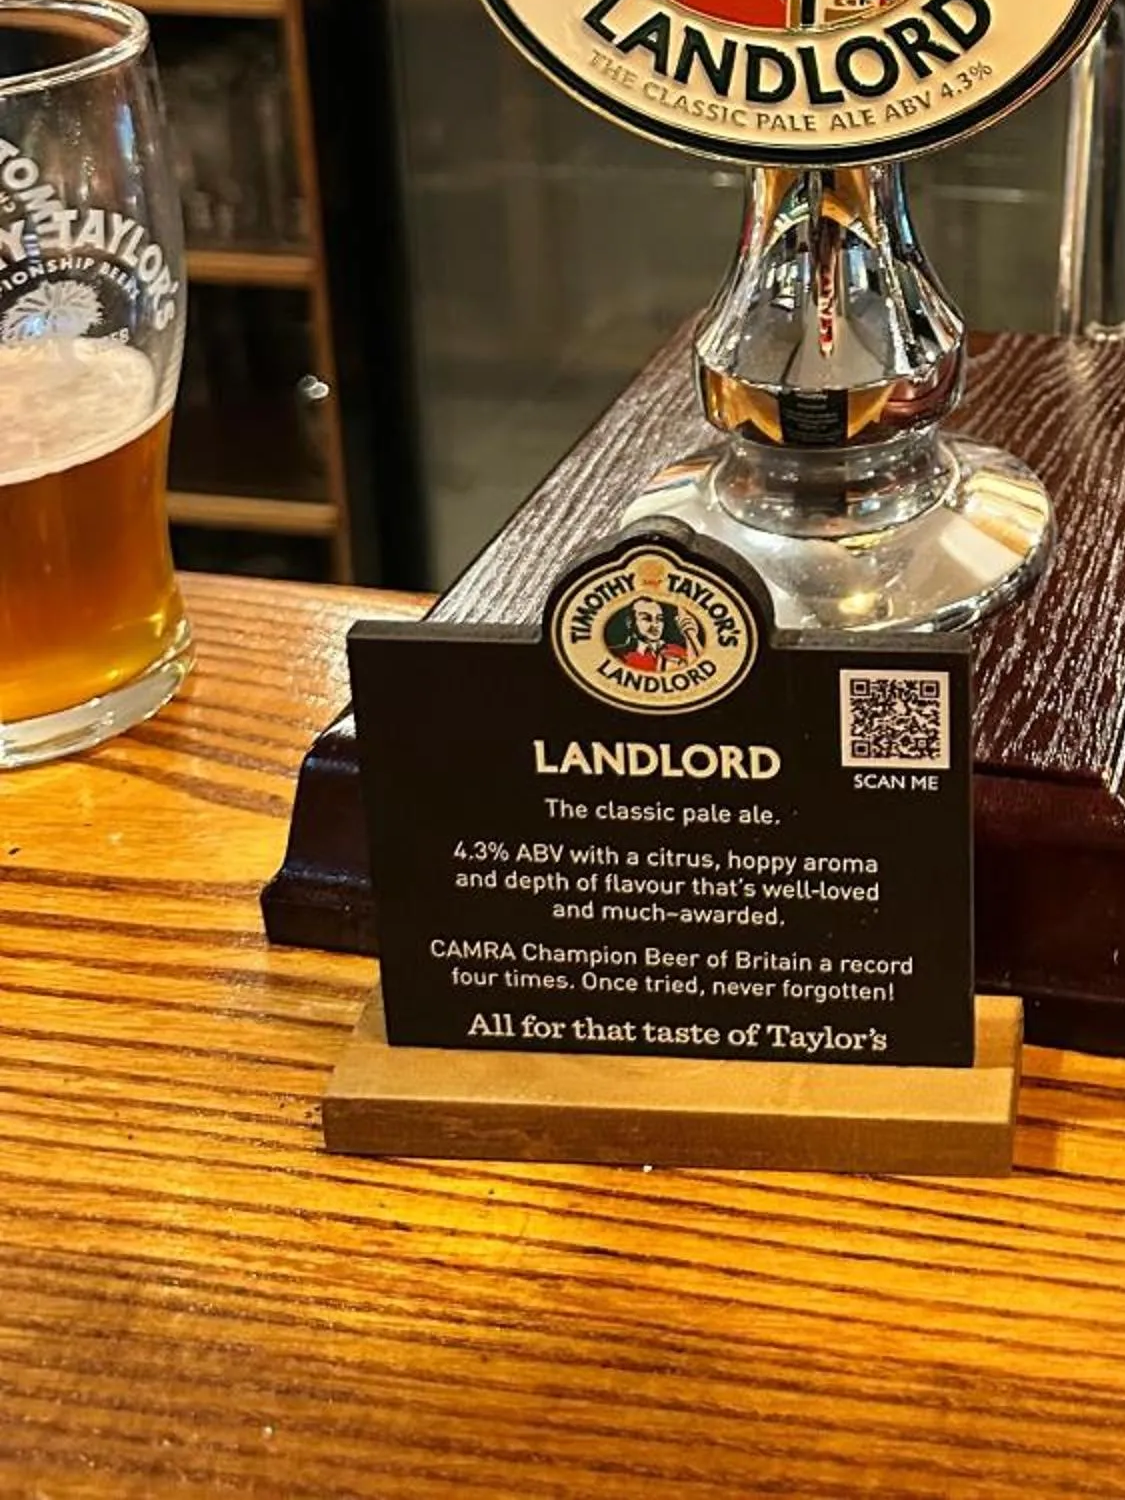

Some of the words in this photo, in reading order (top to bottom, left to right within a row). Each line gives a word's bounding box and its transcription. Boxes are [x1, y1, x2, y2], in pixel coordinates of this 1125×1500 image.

[589, 49, 637, 87] THE
[643, 81, 748, 128] CLASSIC
[757, 113, 818, 132] PALE
[829, 111, 877, 132] ALE
[884, 90, 933, 124] ABV
[940, 60, 993, 99] 4.3%
[570, 573, 636, 644] TIMOTHY
[667, 573, 742, 648] TAYLOR'S
[597, 659, 717, 694] LANDLORD
[533, 739, 781, 779] LANDLORD
[853, 773, 906, 789] SCAN
[911, 775, 938, 791] ME
[545, 798, 588, 819] The
[595, 800, 675, 822] classic
[683, 803, 731, 827] pale
[738, 805, 782, 825] ale.
[453, 840, 509, 862] 4.3%
[515, 843, 564, 863] ABV
[569, 845, 619, 865] with
[626, 851, 639, 866] a
[647, 847, 721, 871] citrus,
[728, 850, 797, 875] hoppy
[803, 857, 878, 874] aroma
[455, 869, 497, 888] and
[504, 870, 569, 895] depth
[576, 873, 598, 892] of
[604, 873, 686, 895] flavour
[691, 877, 756, 898] that's
[762, 879, 880, 902] well-loved
[552, 900, 594, 919] and
[602, 903, 785, 926] much-awarded.
[430, 939, 516, 960] CAMRA
[522, 942, 637, 968] Champion
[645, 947, 700, 967] Beer
[706, 949, 728, 968] of
[735, 950, 812, 971] Britain
[819, 957, 833, 972] a
[840, 956, 913, 975] record
[451, 967, 499, 986] four
[504, 969, 575, 989] times.
[581, 971, 638, 992] Once
[645, 974, 705, 997] tried,
[712, 981, 777, 997] never
[782, 979, 894, 1004] forgotten!
[467, 1013, 516, 1037] All
[521, 1014, 566, 1039] for
[571, 1016, 637, 1042] that
[642, 1022, 721, 1045] taste
[727, 1023, 761, 1047] of
[766, 1024, 887, 1054] Taylor's
